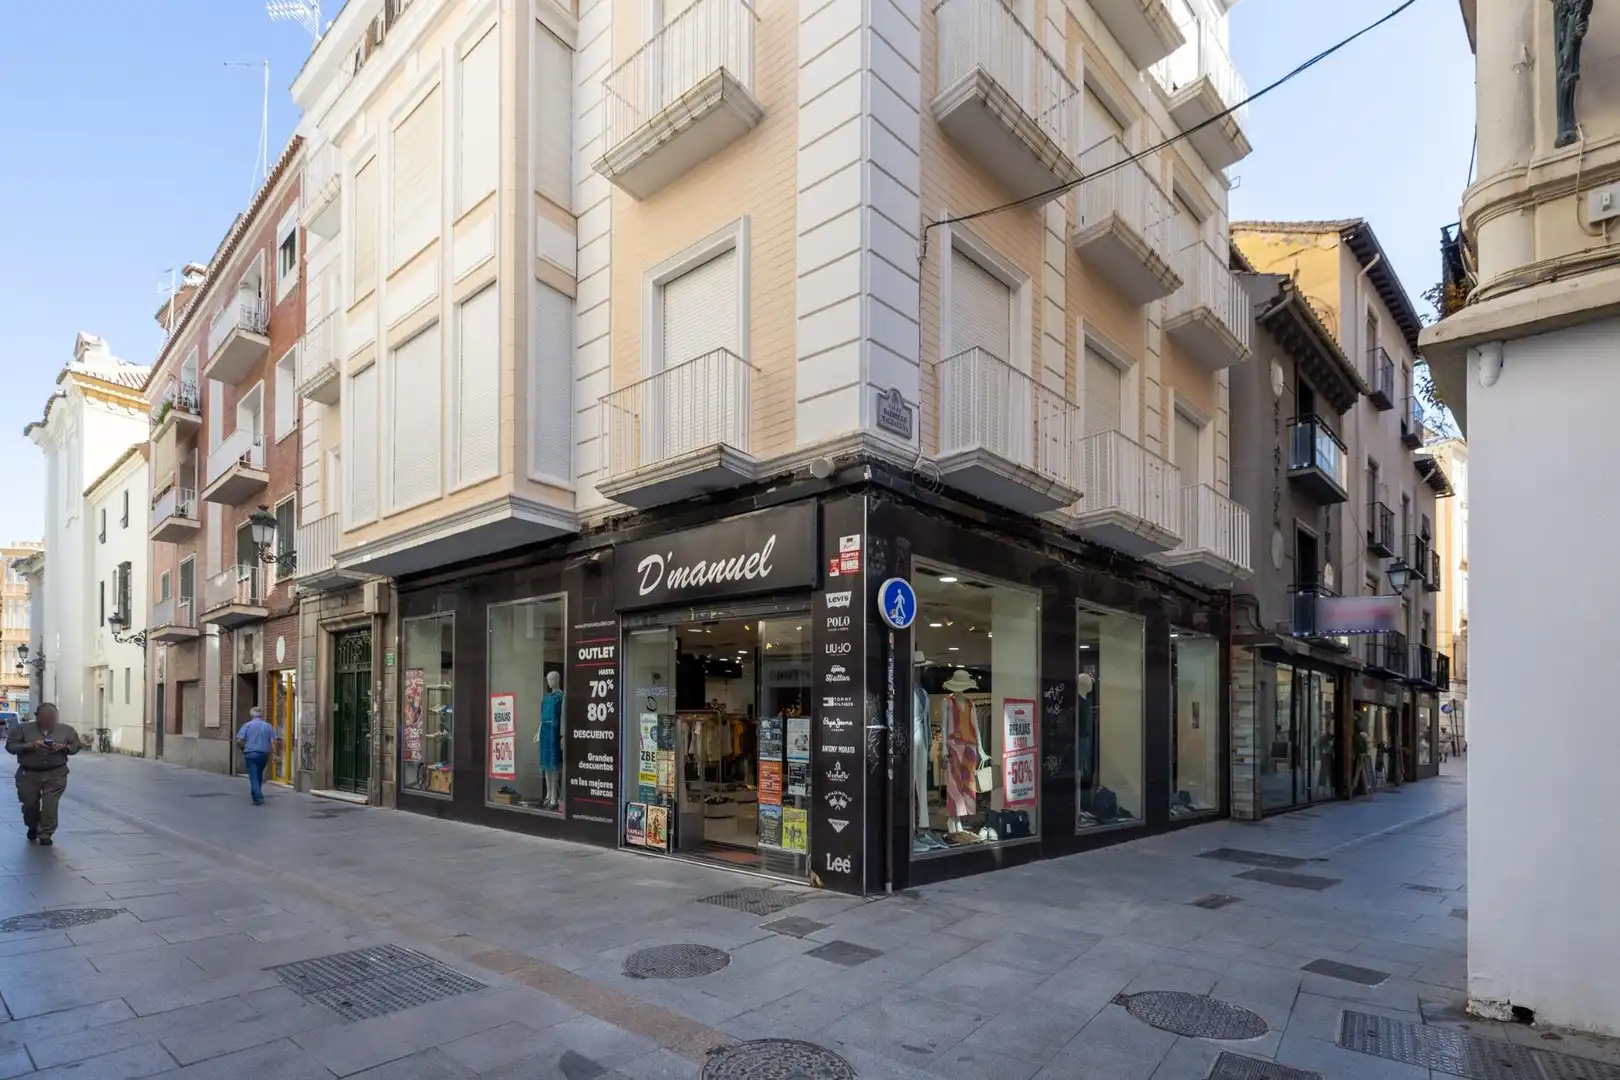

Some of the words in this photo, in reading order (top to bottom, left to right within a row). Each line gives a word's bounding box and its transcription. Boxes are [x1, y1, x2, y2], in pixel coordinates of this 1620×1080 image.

[637, 534, 776, 596] D'manuel
[826, 616, 850, 627] POLO
[578, 646, 615, 659] OUTLET
[589, 679, 614, 697] 70%
[587, 702, 614, 721] 80%
[573, 729, 614, 739] DESCUENTO
[587, 752, 613, 762] Grandes
[641, 750, 656, 762] ZBE
[578, 761, 613, 771] descuentos
[578, 776, 588, 787] las
[588, 779, 613, 789] mejores
[590, 788, 613, 797] marcas
[826, 852, 851, 874] Lee
